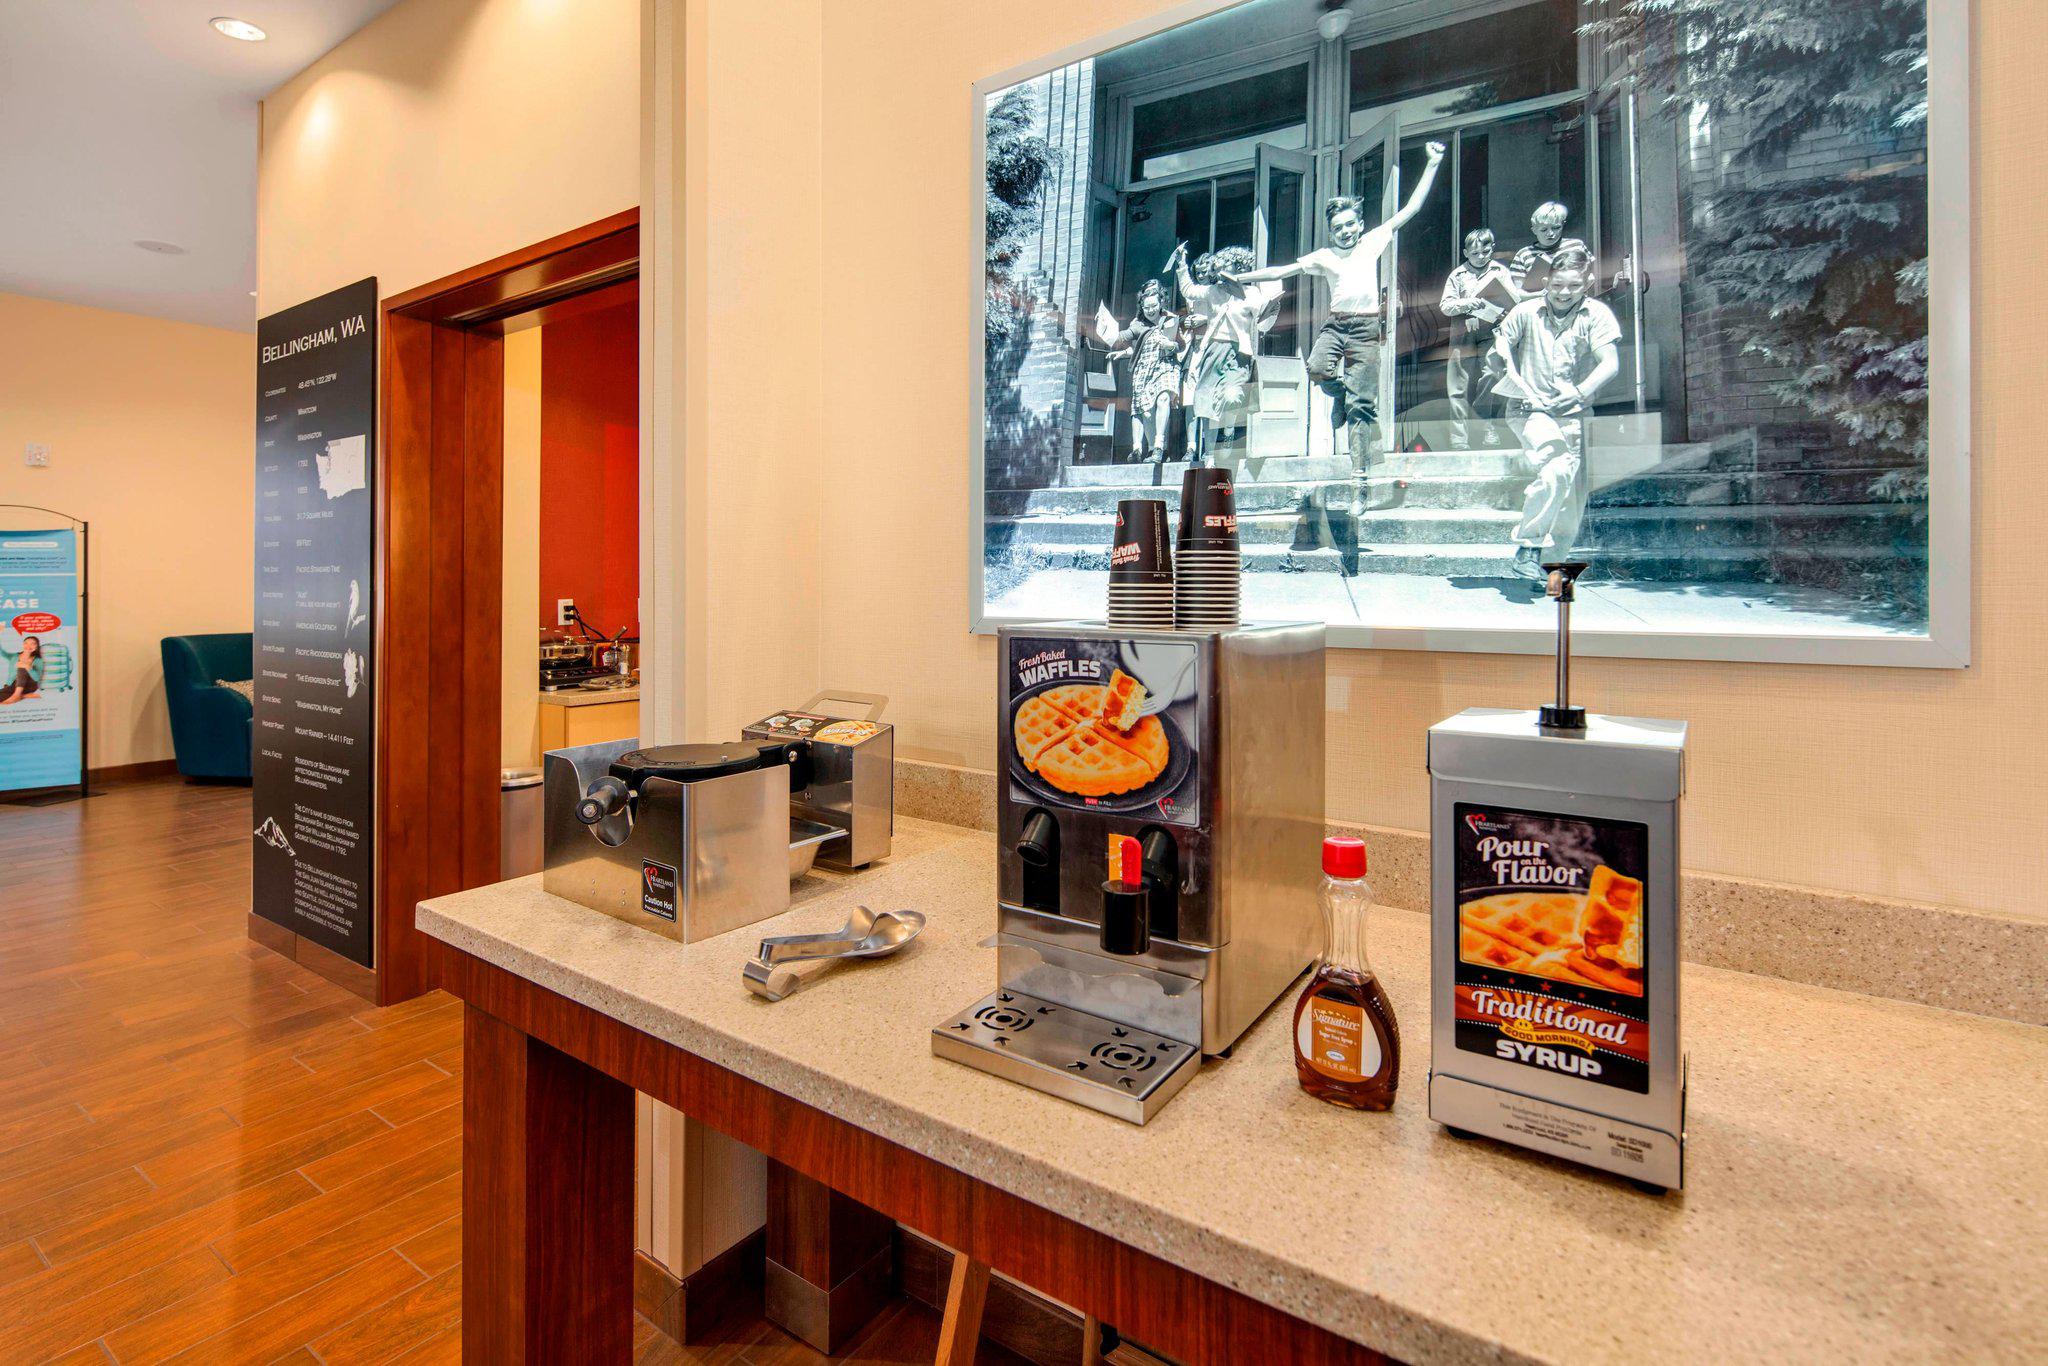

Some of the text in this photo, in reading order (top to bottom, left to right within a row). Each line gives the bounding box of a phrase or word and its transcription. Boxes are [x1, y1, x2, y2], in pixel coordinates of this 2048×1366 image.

[263, 315, 366, 364] BELLINGHAM, WA
[1204, 514, 1237, 527] FFLES
[1112, 542, 1142, 558] WAFF
[1018, 649, 1066, 672] Fresh Baked
[1018, 660, 1101, 688] WAFFLES
[1475, 820, 1510, 830] HEARTLAND
[1476, 836, 1549, 862] Pour
[1492, 859, 1584, 886] Flavor
[1520, 857, 1547, 867] on the
[650, 875, 674, 888] HEARTLAND
[645, 894, 673, 911] Caution Hot
[1313, 1009, 1360, 1032] Signature
[1471, 990, 1628, 1045] Traditional
[1504, 1025, 1591, 1049] GOOD MORNING!
[1496, 1039, 1602, 1078] SYRUP
